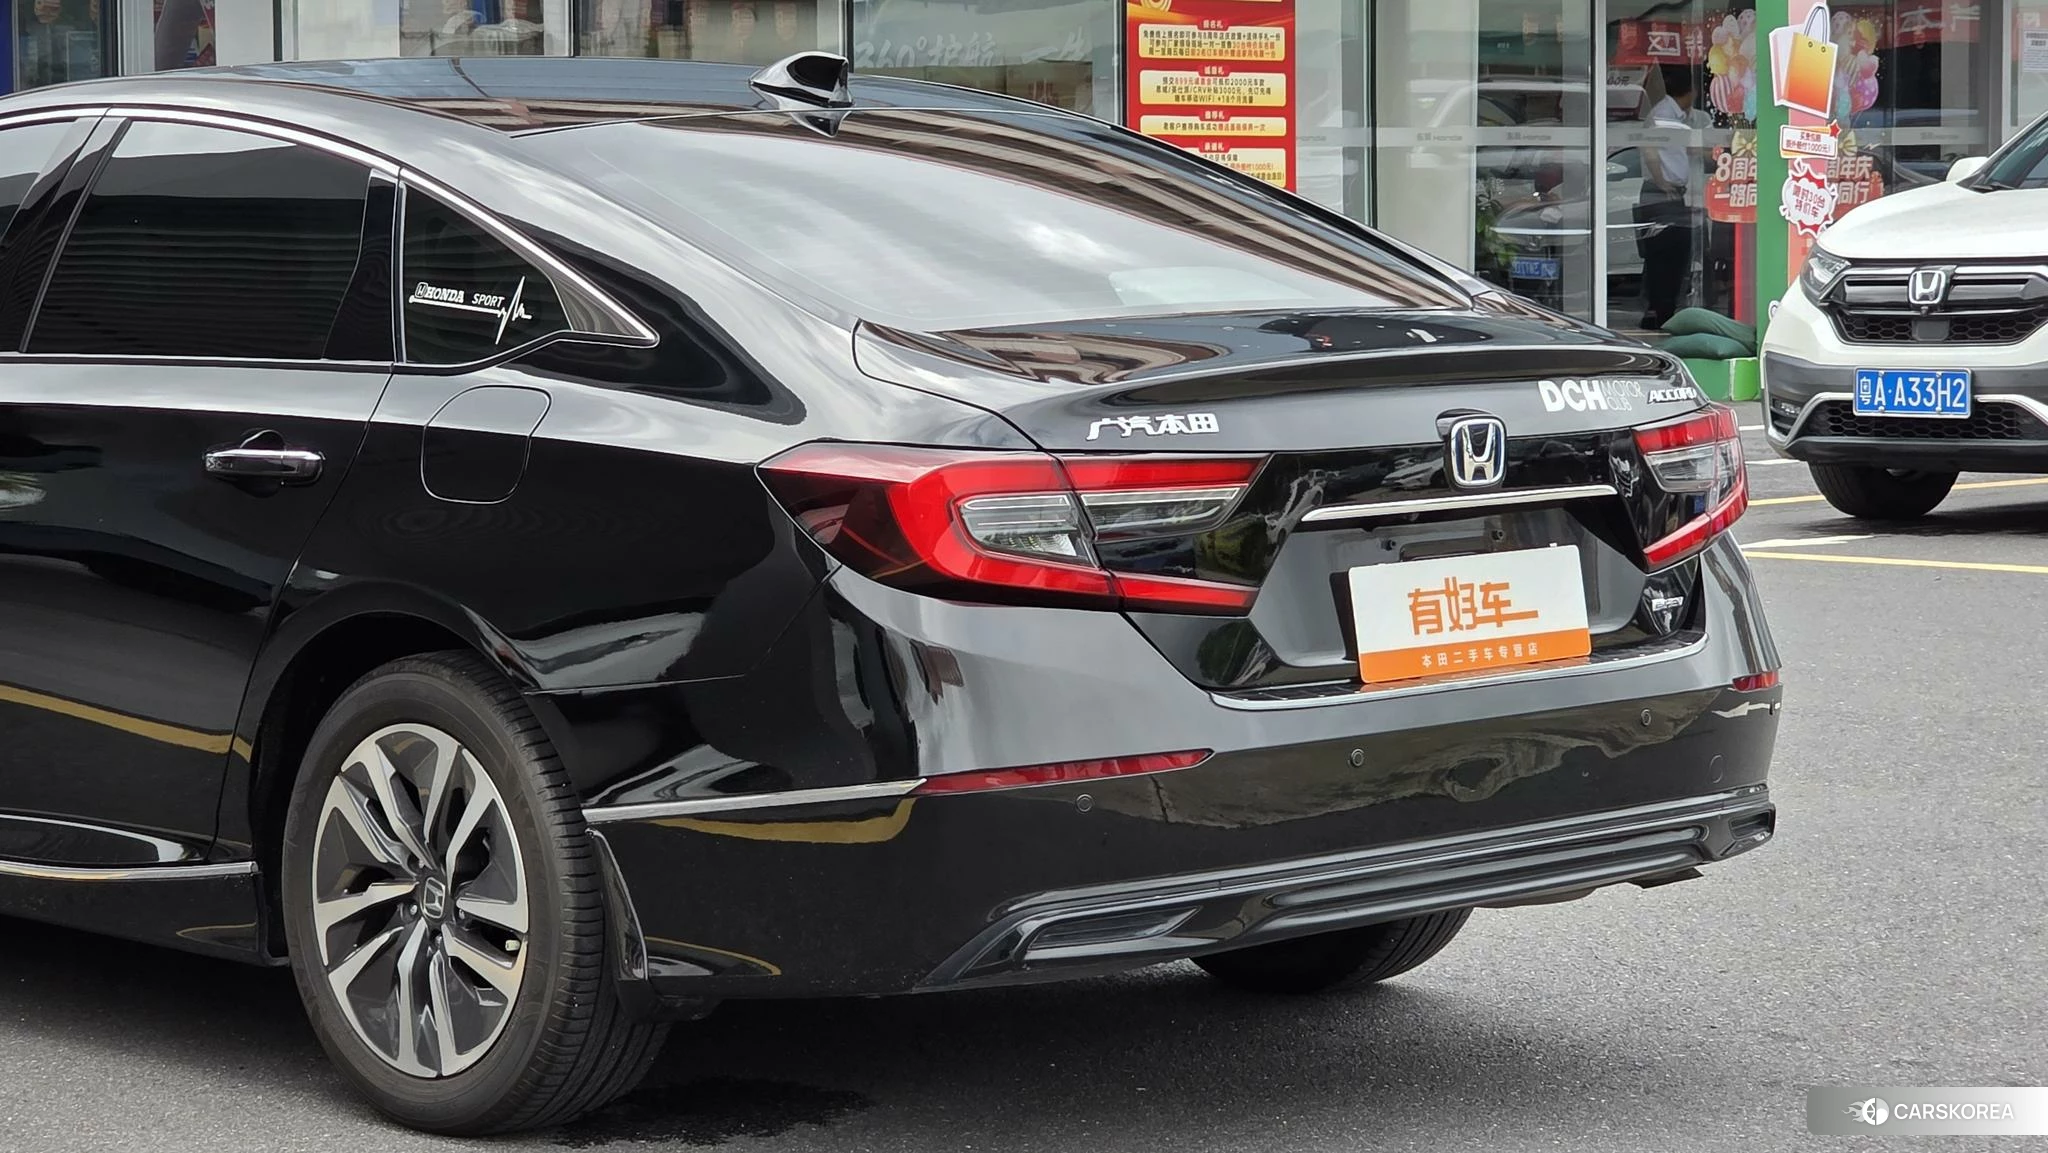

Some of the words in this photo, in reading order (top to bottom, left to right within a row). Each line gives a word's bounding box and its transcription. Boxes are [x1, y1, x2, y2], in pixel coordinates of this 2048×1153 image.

[425, 286, 465, 304] HONDA
[471, 293, 505, 308] SPORT
[1538, 379, 1608, 412] DCH
[1601, 380, 1645, 398] MOTOR
[1085, 413, 1220, 441] 广汽本田
[1407, 576, 1539, 637] 有好车
[1421, 642, 1539, 668] 本田二手车专营店
